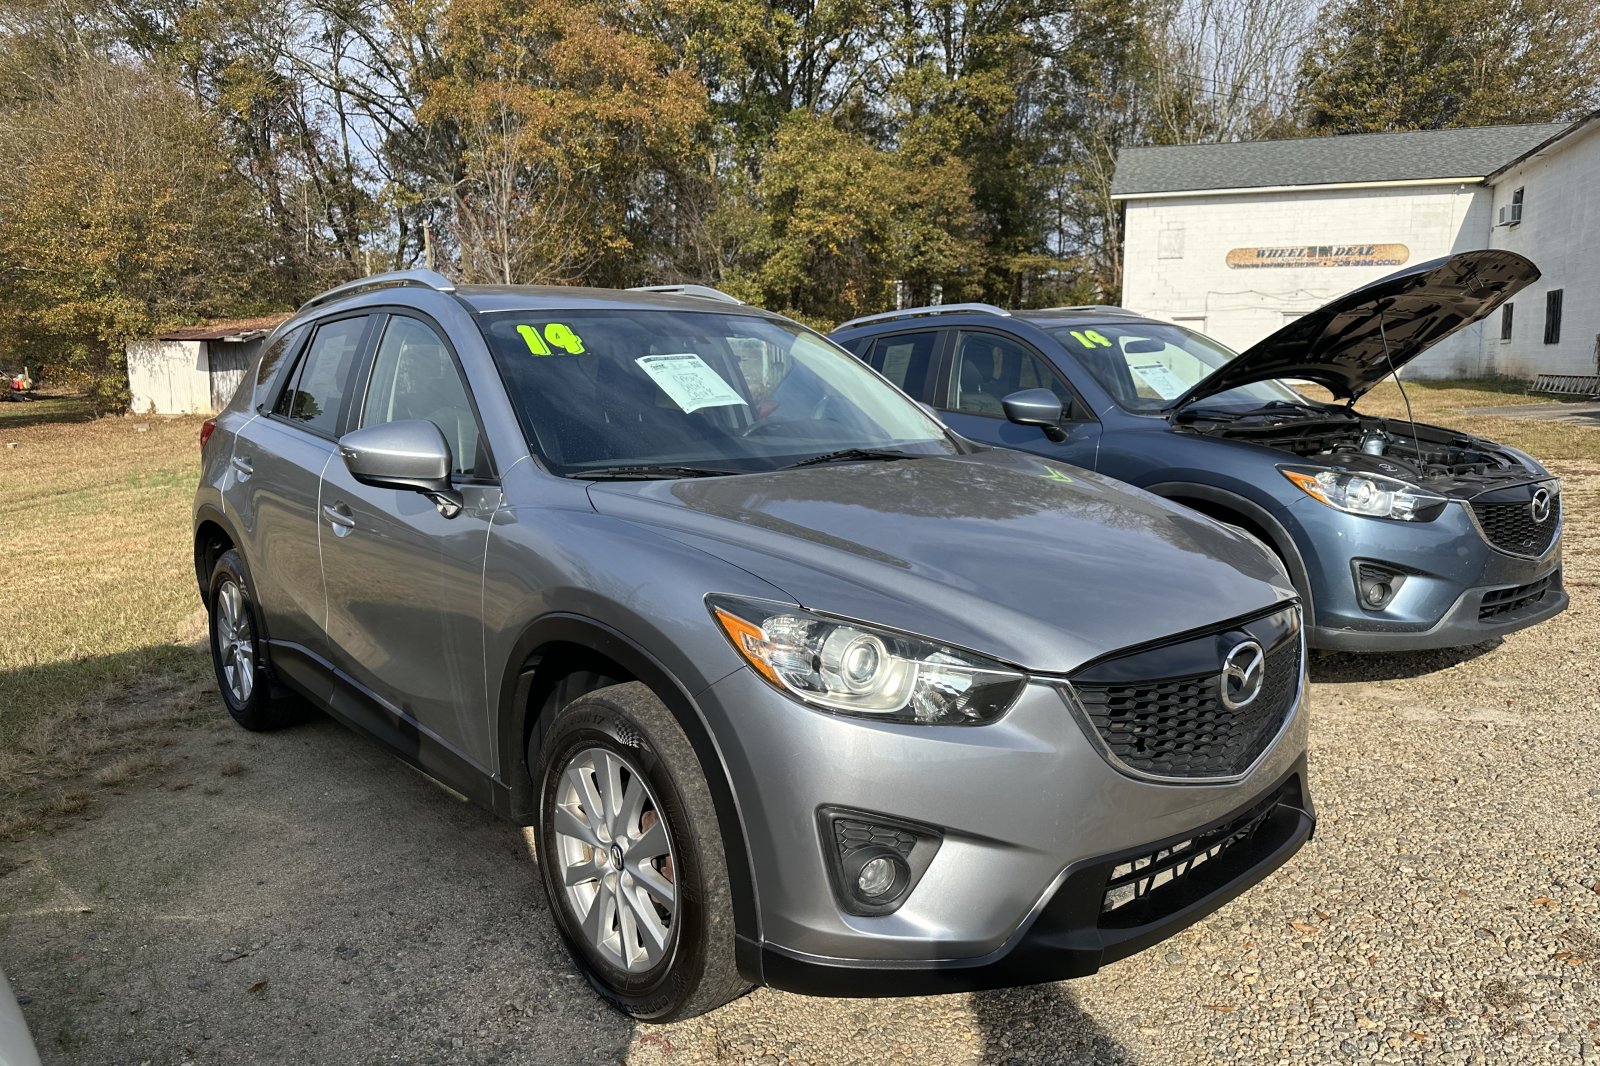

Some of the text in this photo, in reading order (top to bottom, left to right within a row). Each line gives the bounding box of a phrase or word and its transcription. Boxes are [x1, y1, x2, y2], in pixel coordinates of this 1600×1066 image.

[1256, 248, 1305, 258] WHEEL
[1334, 244, 1375, 257] DEAL
[516, 323, 586, 356] 14
[1070, 330, 1113, 349] 14
